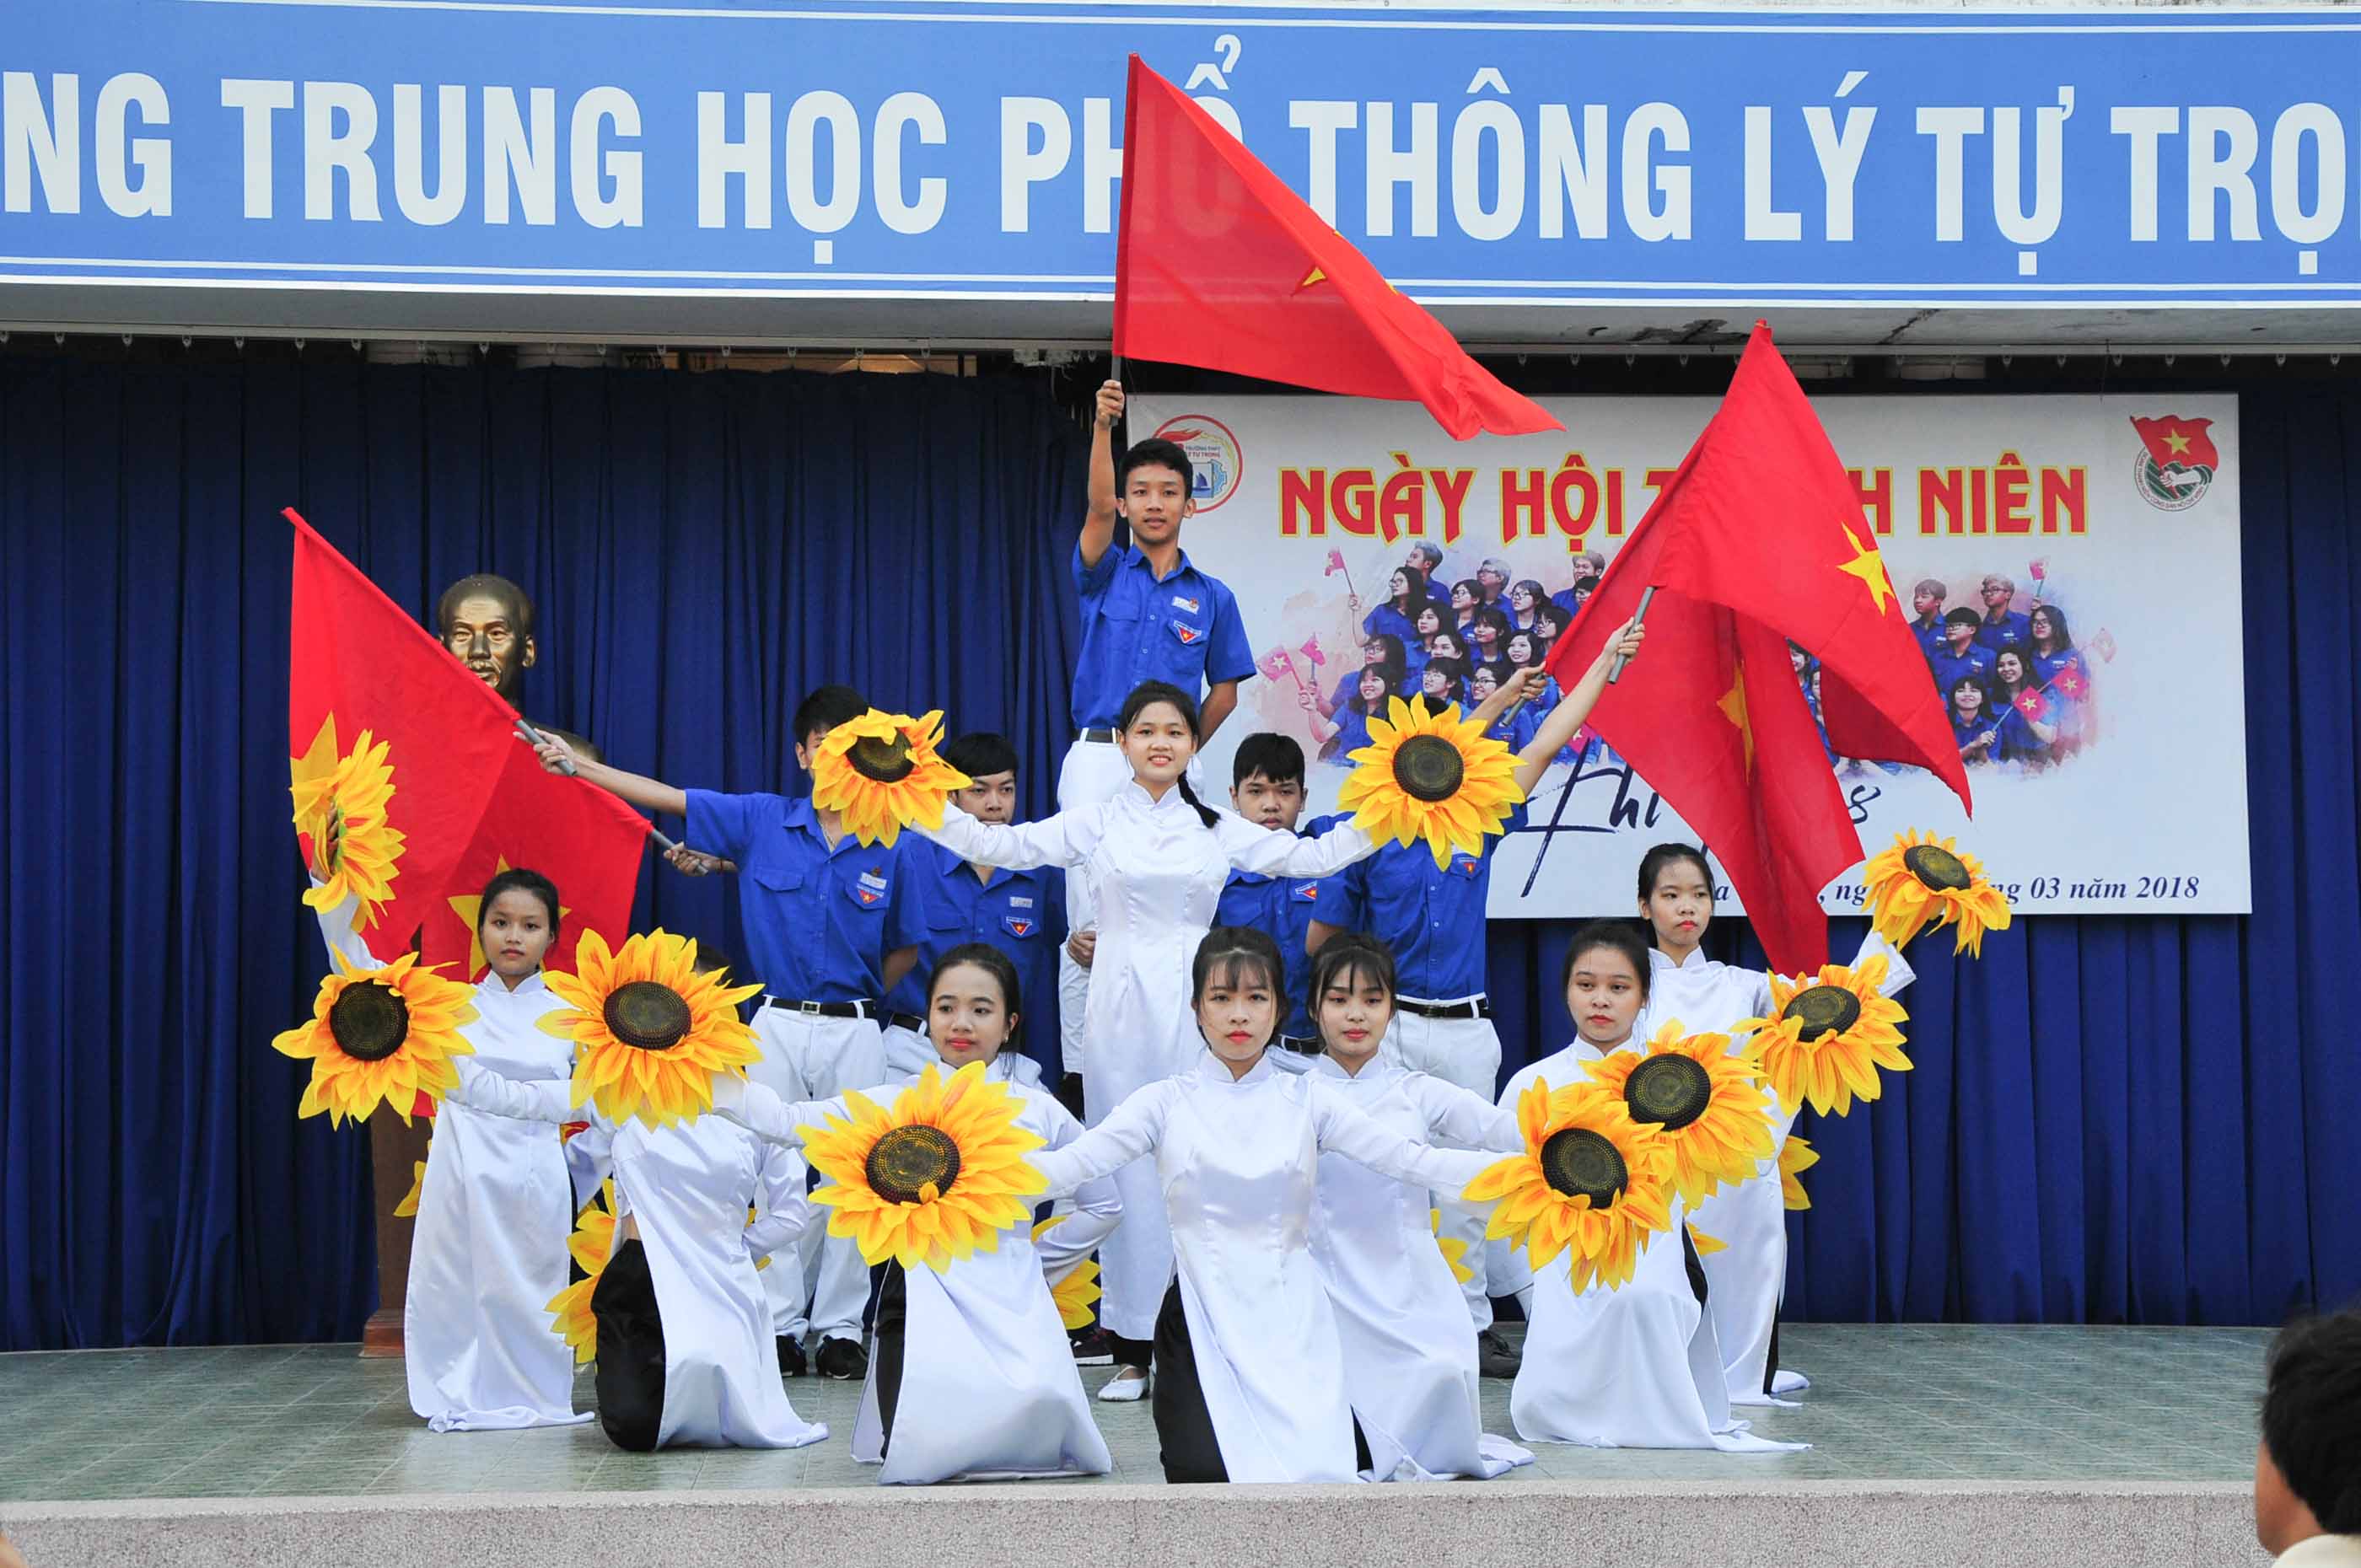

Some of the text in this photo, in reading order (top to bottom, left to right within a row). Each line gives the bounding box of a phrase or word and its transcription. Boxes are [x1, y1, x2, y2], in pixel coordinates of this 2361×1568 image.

[221, 78, 643, 228] TRUNG
[697, 90, 947, 265] HỌC
[1288, 67, 1691, 242] THÔNG
[1745, 71, 1878, 242] LÝ
[1916, 85, 2075, 276] TỰ
[2111, 102, 2361, 275] TRỌ
[1278, 450, 1478, 547] NGÀY
[1498, 450, 1627, 556] HỘI
[1917, 449, 2089, 538] NIÊN
[2030, 876, 2061, 899] 03
[2070, 878, 2127, 899] năm
[2136, 876, 2200, 899] 2018
